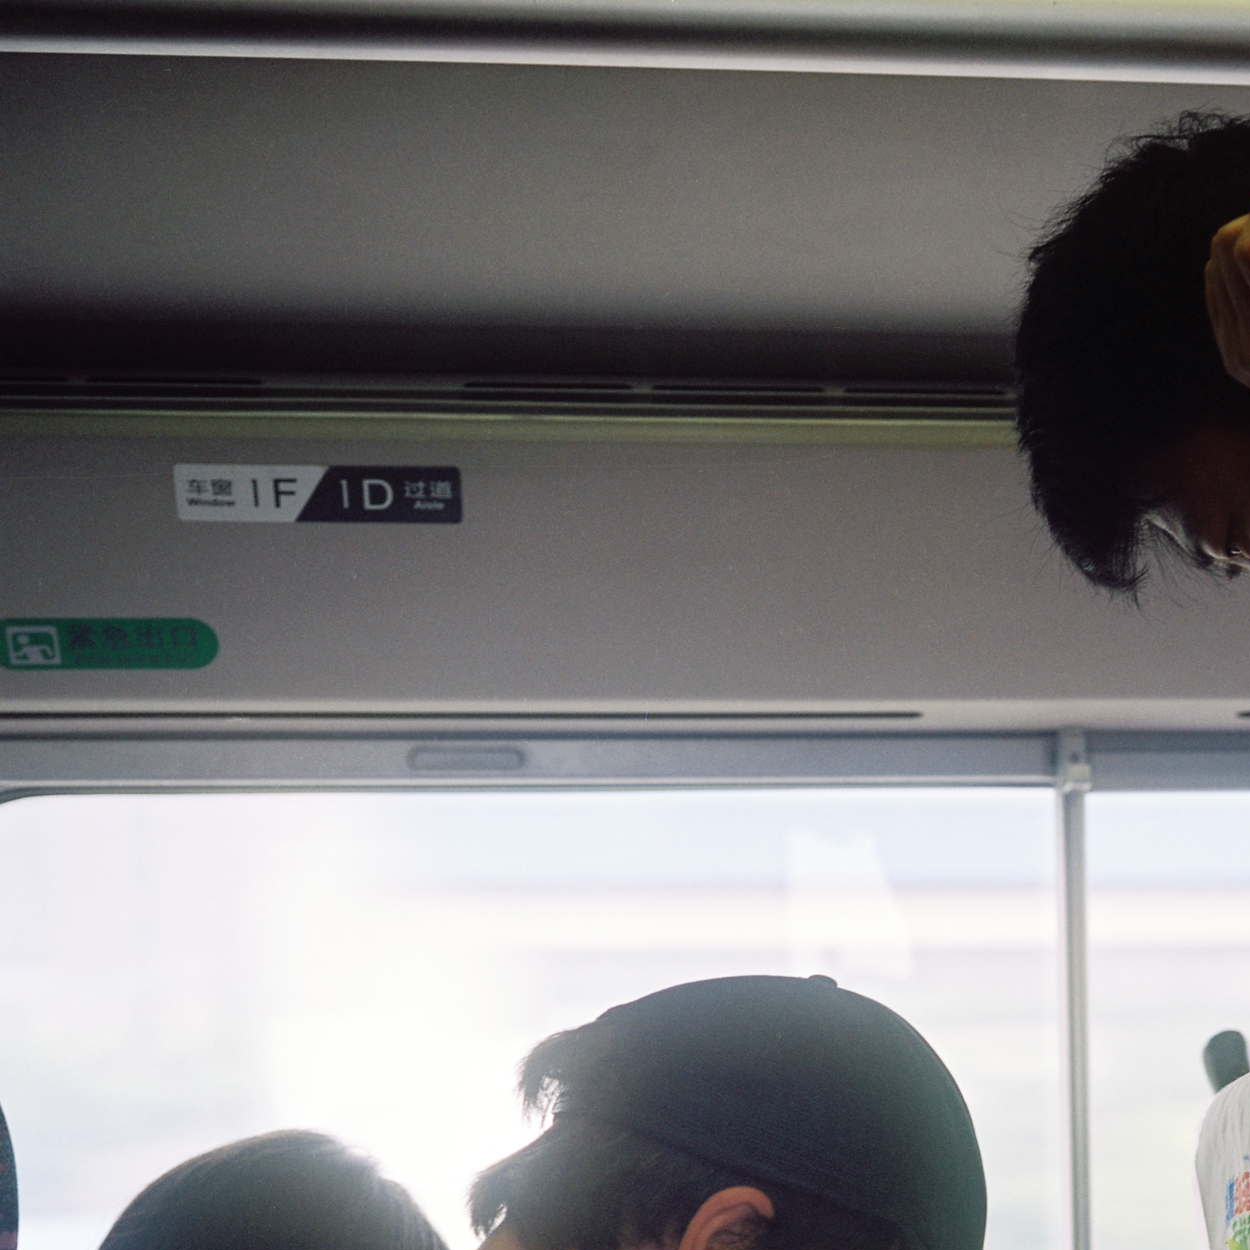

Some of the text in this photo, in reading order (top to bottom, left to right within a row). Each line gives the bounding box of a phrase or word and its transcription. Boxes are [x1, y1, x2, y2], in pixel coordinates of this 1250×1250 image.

[186, 478, 233, 496] 车窗
[403, 480, 453, 499] 过道
[187, 498, 236, 508] Window
